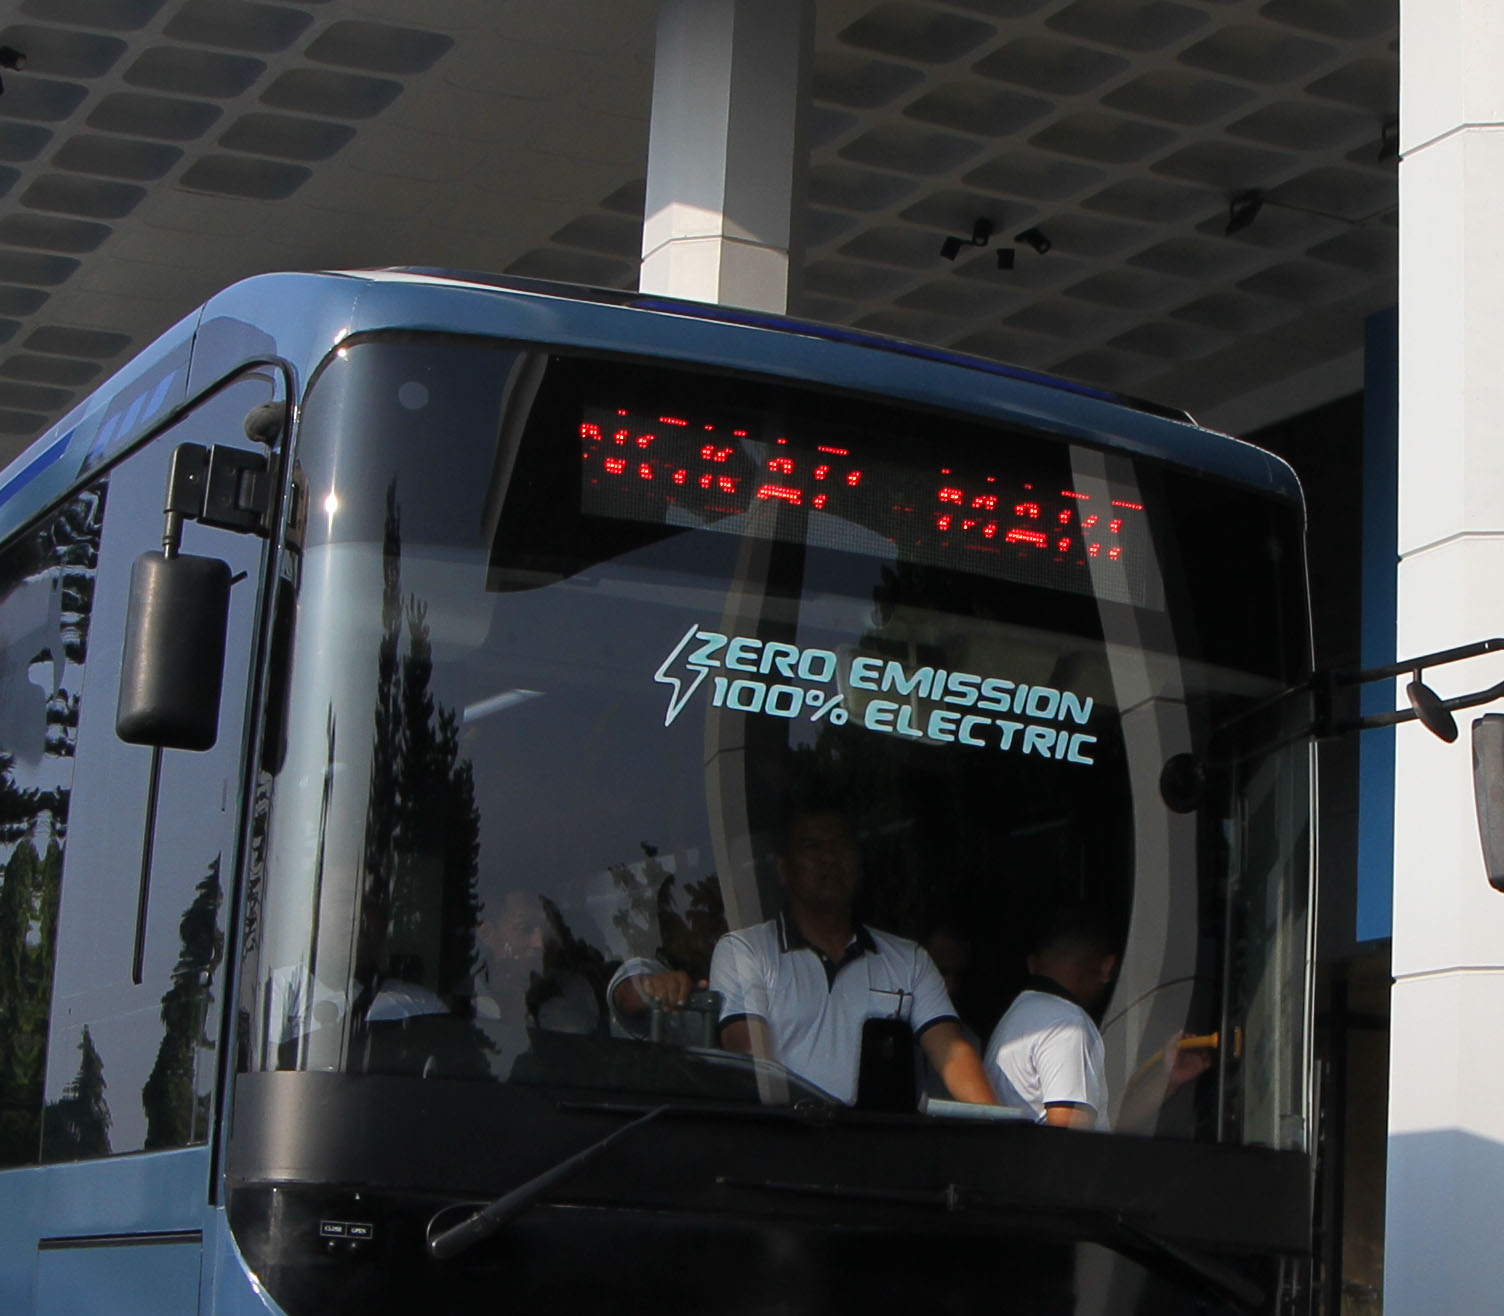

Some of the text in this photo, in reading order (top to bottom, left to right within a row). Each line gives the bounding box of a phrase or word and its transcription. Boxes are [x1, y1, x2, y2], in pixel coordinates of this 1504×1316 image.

[687, 631, 1094, 726] ZERO EMISSION
[712, 676, 1098, 765] 100% ELECTRIC
